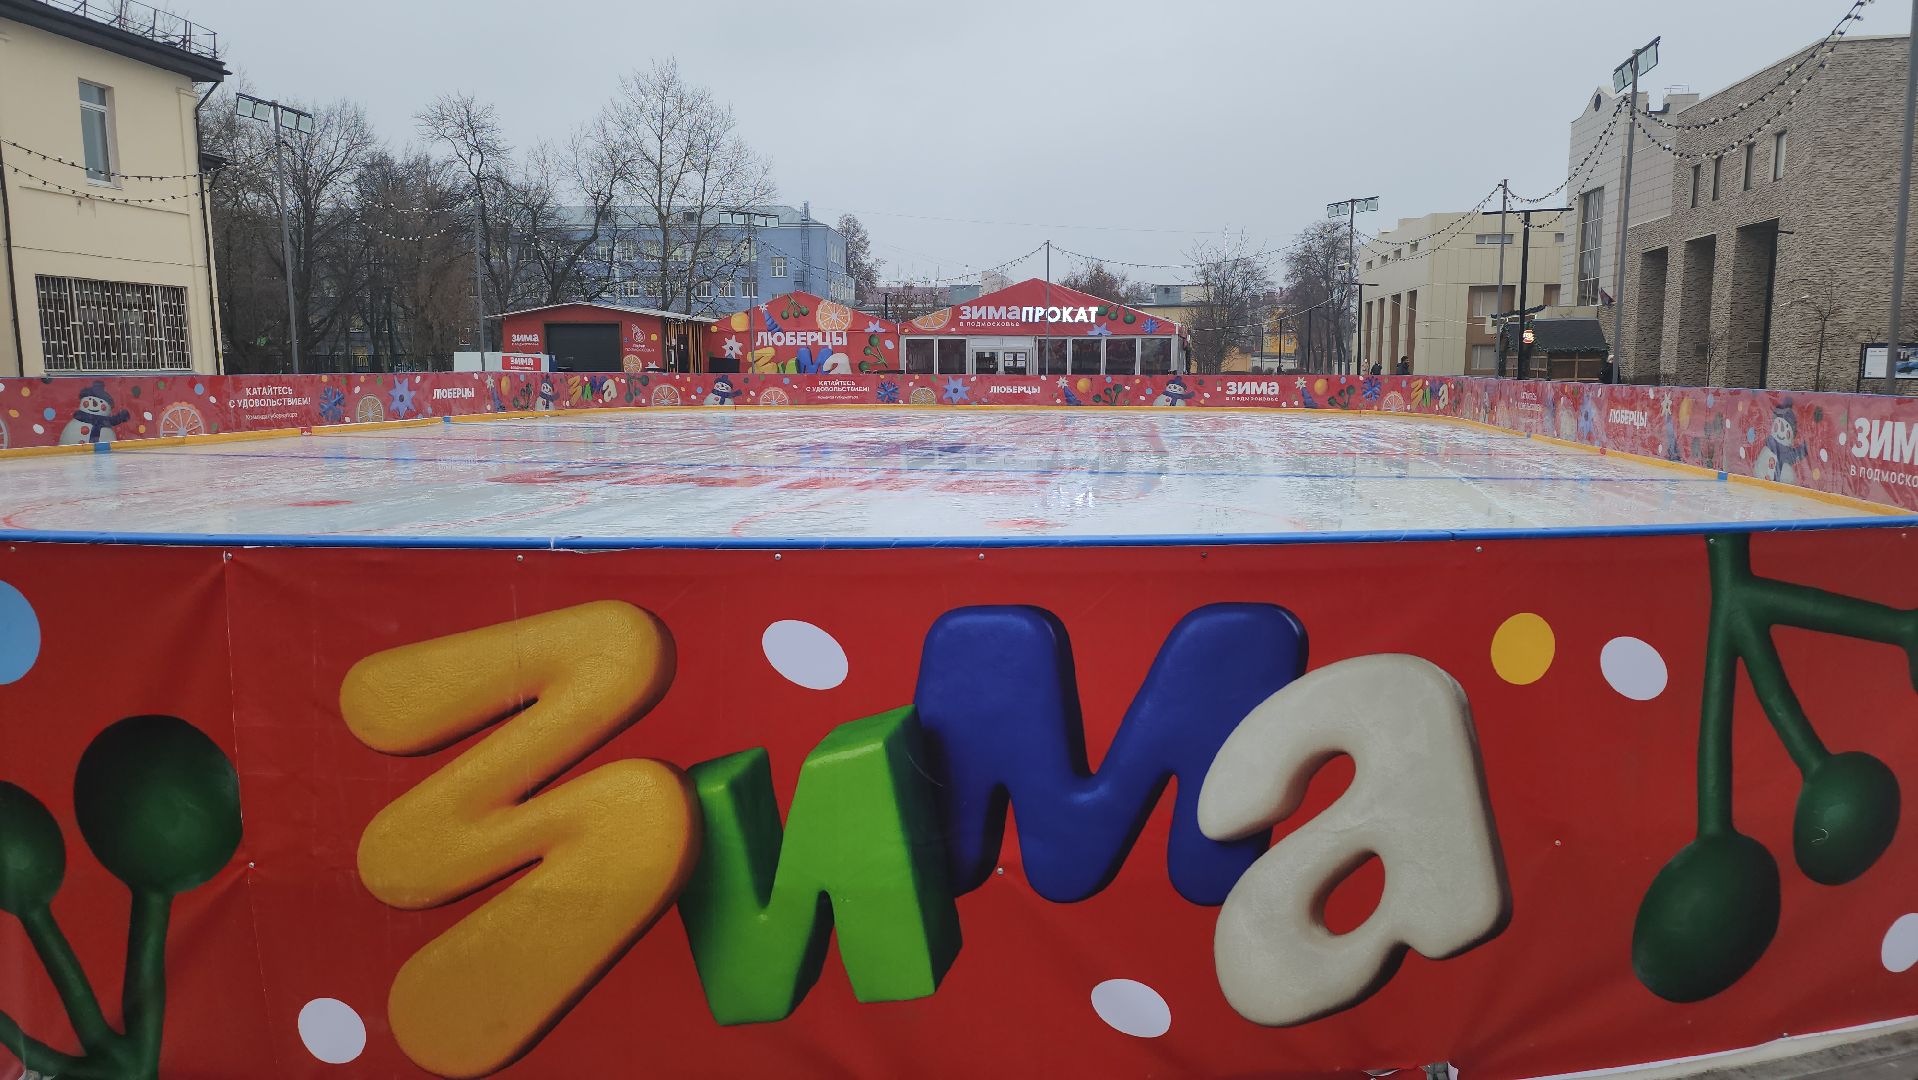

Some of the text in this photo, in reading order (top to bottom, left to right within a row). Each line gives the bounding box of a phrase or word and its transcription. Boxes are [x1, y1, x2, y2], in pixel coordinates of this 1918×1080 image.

[1021, 306, 1099, 323] ПРОКАТ
[756, 331, 848, 350] ЛЮБЕРЦЫ
[245, 385, 293, 396] КАТАЙТЕСЬ
[432, 387, 475, 400] ЛЮБЕРЦЫ
[988, 385, 1041, 395] ЛЮБЕРЦЫ
[237, 397, 311, 409] УДОВОЛЬСТВИЕМ!
[1608, 408, 1648, 430] ЛЮБЕРЦЫ
